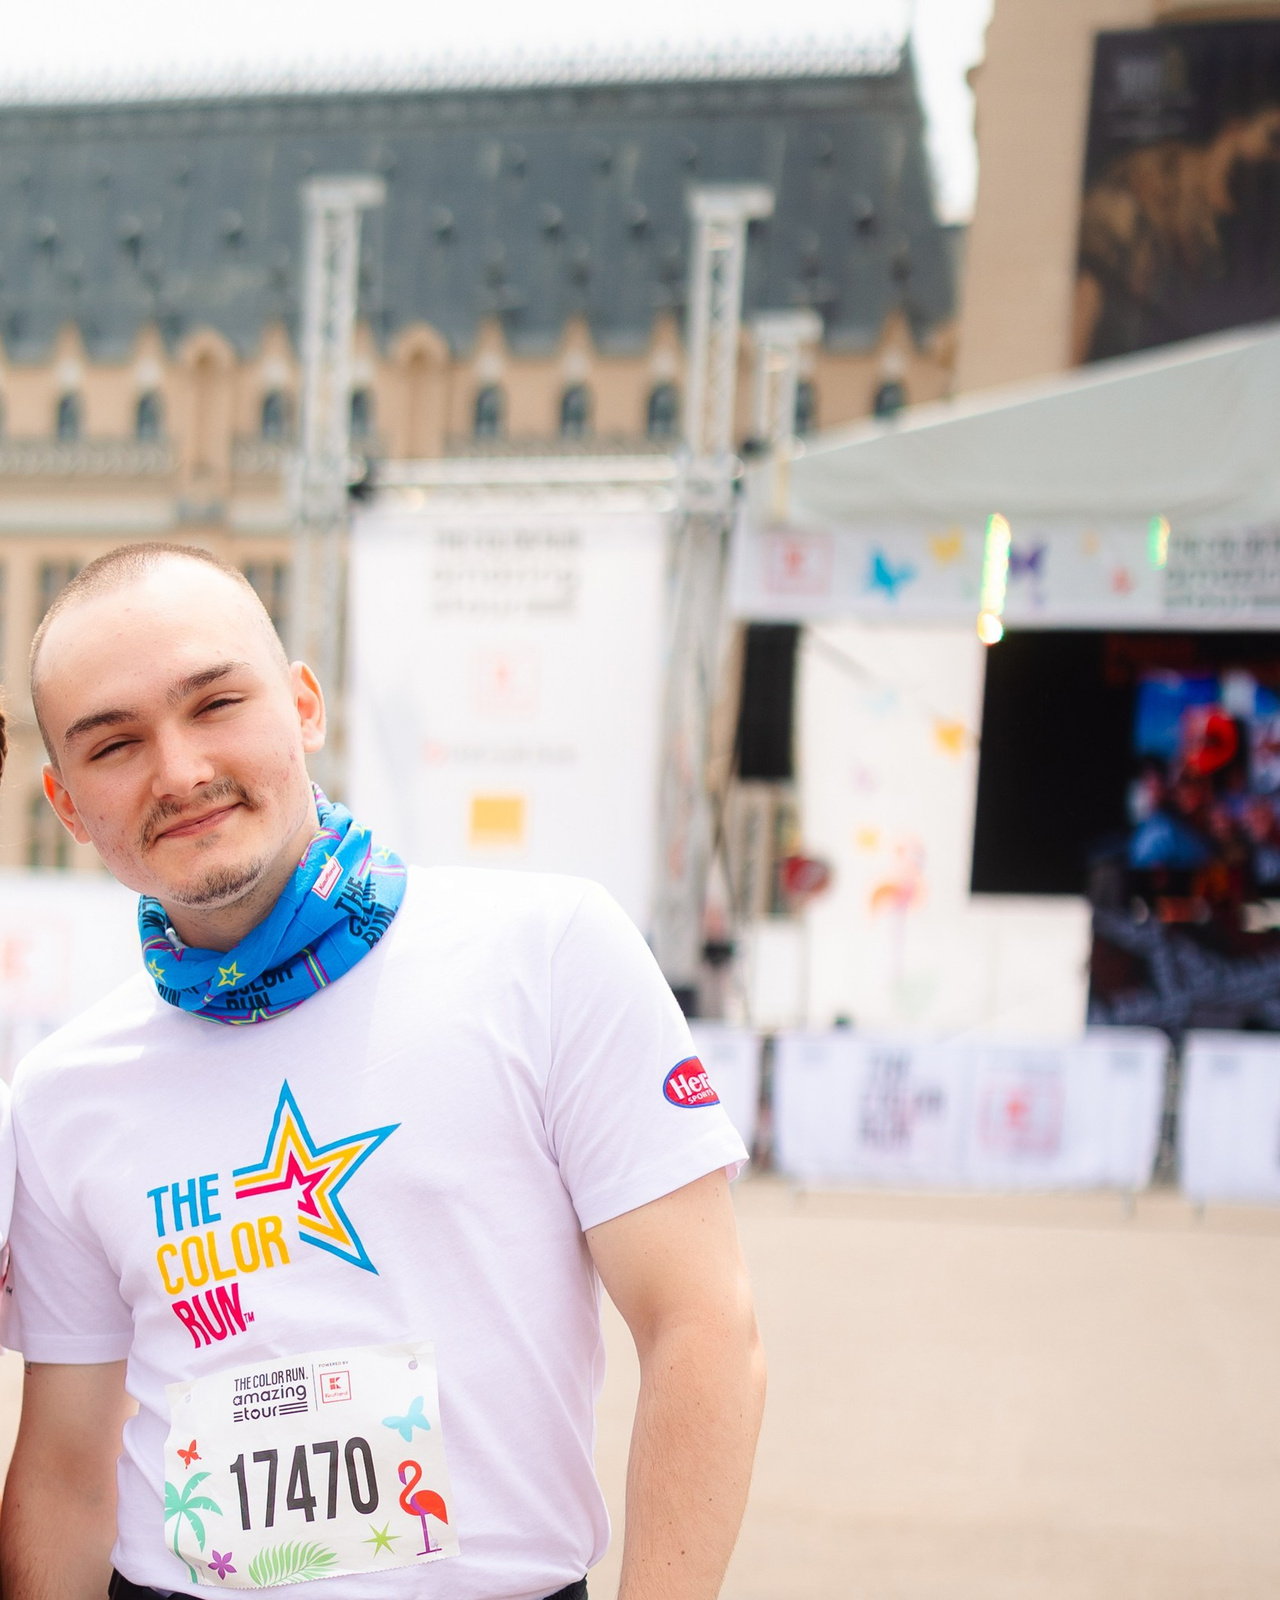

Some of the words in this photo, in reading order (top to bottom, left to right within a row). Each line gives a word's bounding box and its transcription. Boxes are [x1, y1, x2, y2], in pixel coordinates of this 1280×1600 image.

[147, 1173, 221, 1237] THE
[157, 1215, 290, 1295] COLOR
[172, 1282, 247, 1349] RUN
[233, 1385, 307, 1406] amazing
[234, 1376, 251, 1391] THE
[253, 1370, 284, 1388] COLOR
[244, 1406, 277, 1420] tour
[230, 1436, 380, 1531] 17470
